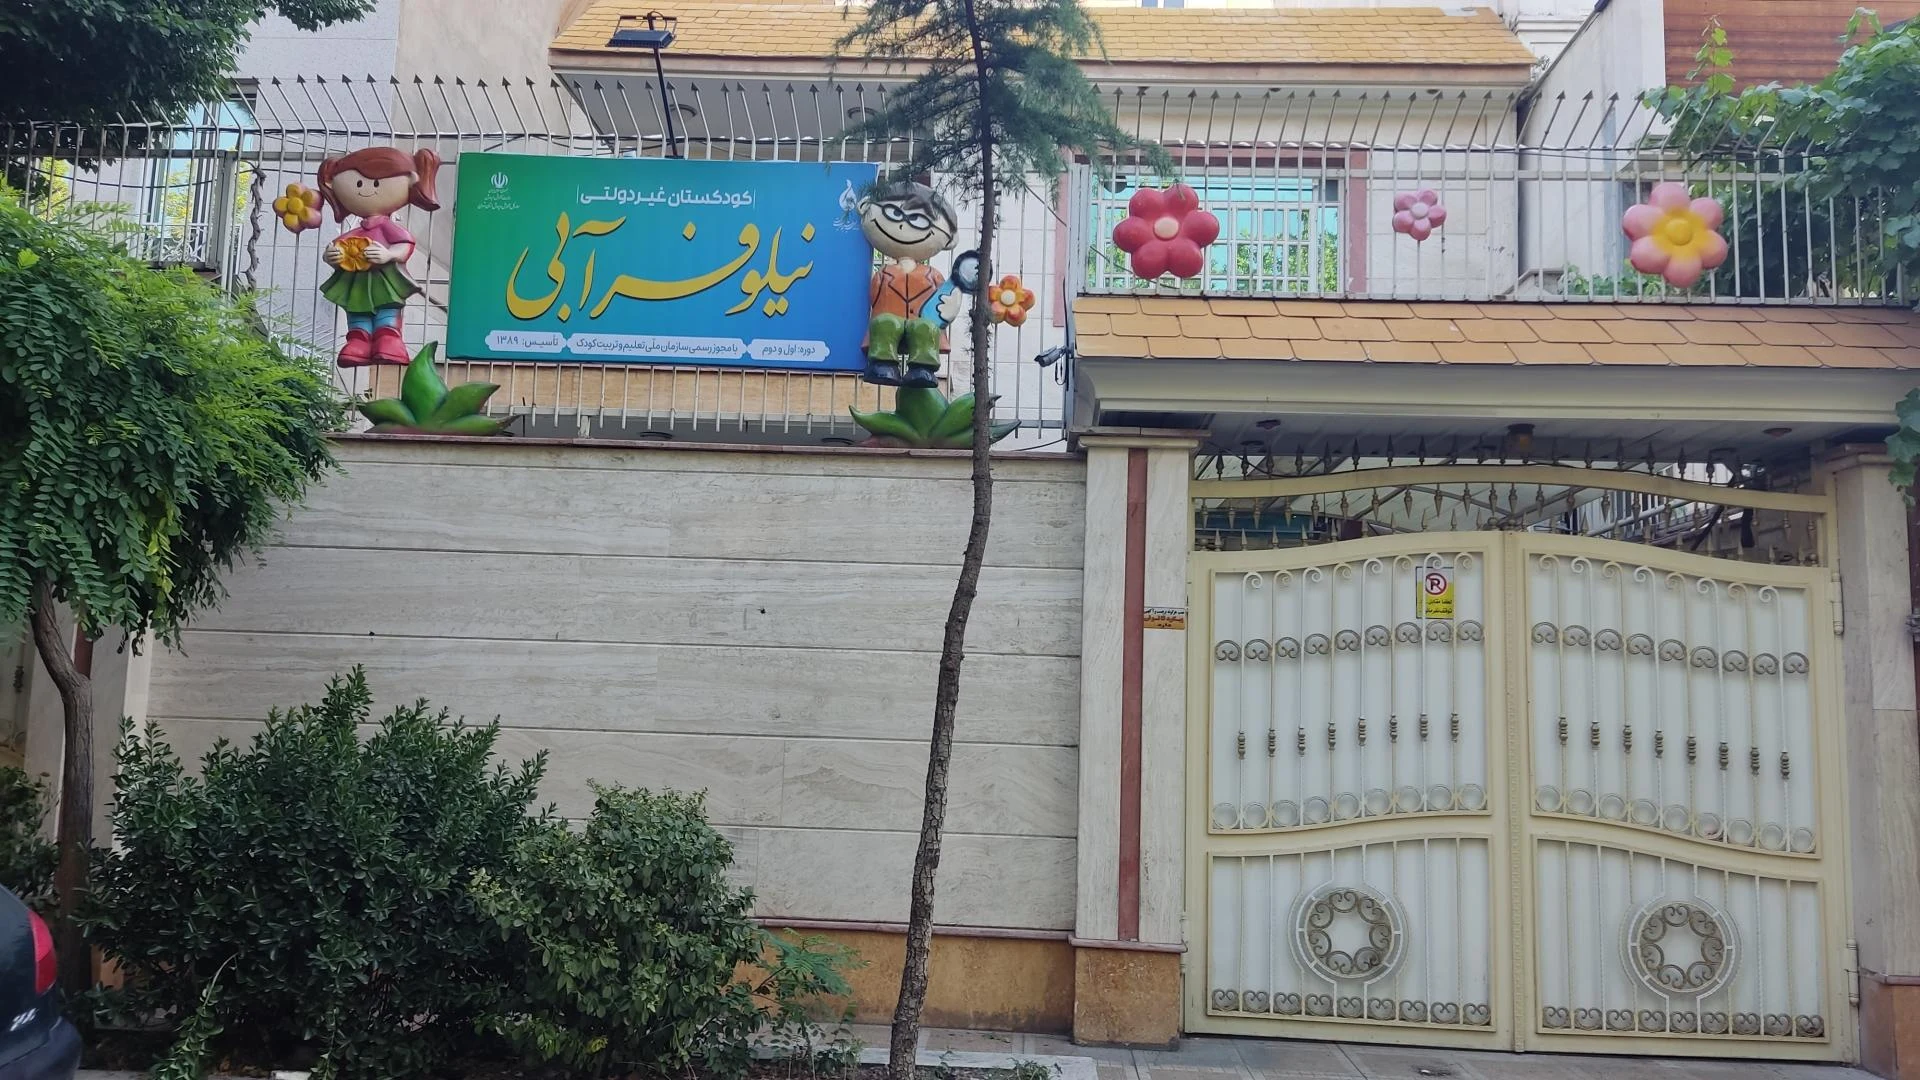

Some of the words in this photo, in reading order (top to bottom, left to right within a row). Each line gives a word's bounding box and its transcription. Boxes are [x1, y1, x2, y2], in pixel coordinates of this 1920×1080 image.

[668, 188, 752, 209] کودکستان
[496, 334, 519, 346] ۱۳۸۹
[576, 338, 597, 351] کودک
[597, 340, 619, 351] تربیت
[622, 340, 646, 353] تعلیم
[661, 341, 689, 353] سازمان
[762, 345, 777, 356] دوم
